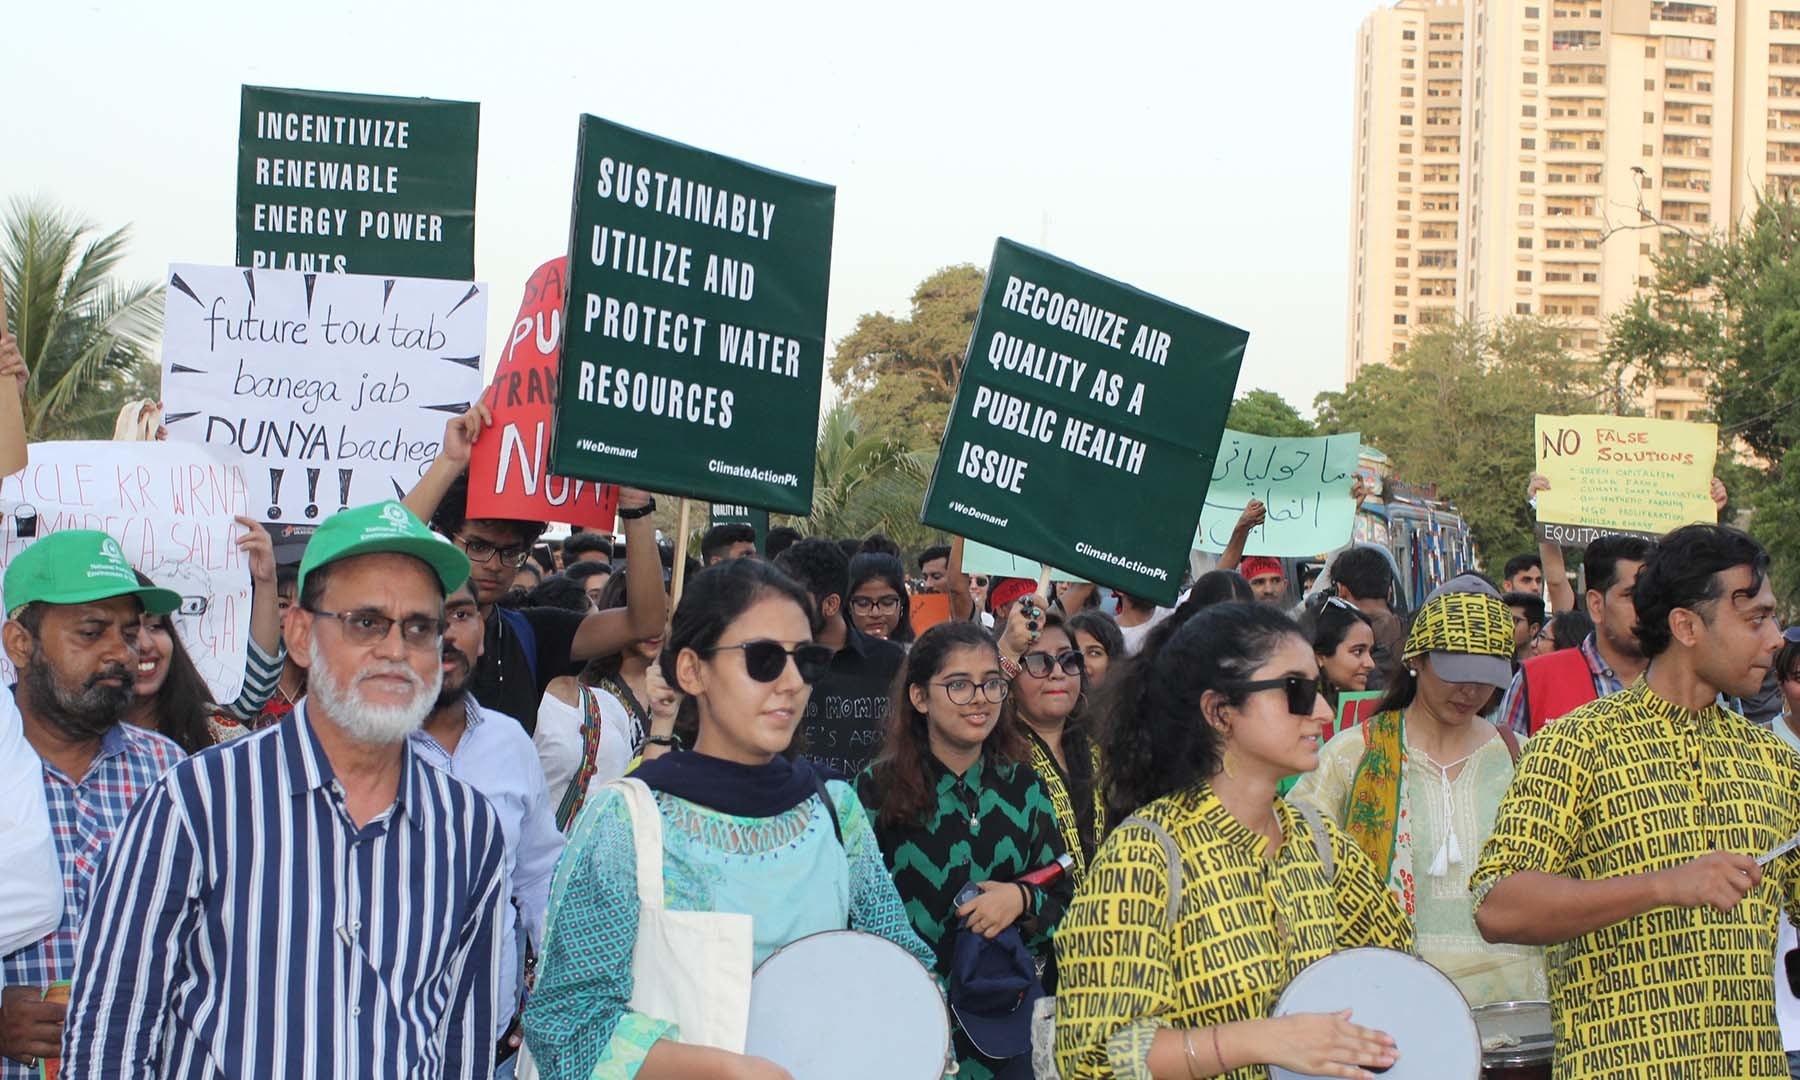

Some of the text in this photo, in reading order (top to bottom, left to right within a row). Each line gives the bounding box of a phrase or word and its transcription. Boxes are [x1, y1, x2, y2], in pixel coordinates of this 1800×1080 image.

[257, 111, 410, 149] INCENTIVIZE
[256, 157, 399, 194] RENEWABLE
[597, 157, 776, 241] SUSTAINABLY
[254, 203, 443, 242] ENERGY POWER
[591, 225, 755, 302] UTILIZE AND
[203, 296, 447, 352] future tou tab
[584, 293, 800, 378] PROTECT WATER
[1001, 275, 1172, 367] RECOGNIZE AIR
[233, 359, 410, 414] banega jab
[987, 331, 1145, 416] QUALITY AS A
[578, 361, 735, 430] RESOURCES
[205, 415, 441, 477] DUNYA bacheg
[576, 439, 638, 459] #WeDemand
[971, 385, 1147, 476] PUBLIC HEALTH
[1542, 428, 1649, 459] NO FALSE
[708, 459, 798, 487] ClimateActionPk
[957, 441, 1028, 494] ISSUE
[1597, 447, 1694, 465] SOLUTIONS
[17, 464, 248, 517] YCLE KR WRNA
[948, 501, 1008, 528] #WeDemand
[1544, 524, 1620, 544] EQUITAB
[172, 521, 240, 570] SALA
[1075, 542, 1169, 582] ClimateActionPk
[826, 695, 897, 719] MOMM
[1525, 755, 1573, 787] GLOBAL
[1608, 787, 1660, 818] ACTION
[1585, 816, 1641, 855] CLIMATE
[1642, 807, 1690, 834] STRIKE
[1647, 907, 1695, 935] STRIKE
[1069, 930, 1142, 959] PAKISTAN
[1201, 932, 1261, 973] ACTION
[1650, 930, 1706, 960] CLIMATE
[1709, 927, 1754, 950] ACTION
[1110, 961, 1169, 996] CLIMATE
[1641, 955, 1701, 985] CLIMATE
[1704, 954, 1745, 977] STRIKE
[1618, 987, 1670, 1016] ACTION
[1673, 981, 1709, 1005] NOW!
[1712, 979, 1771, 1002] PAKISTAN
[1589, 1016, 1647, 1046] CLIMATE
[1650, 1008, 1701, 1036] STRIKE
[1703, 1005, 1748, 1028] GLOBAL
[1582, 1041, 1651, 1074] PAKISTAN
[1654, 1032, 1708, 1060] CLIMATE
[1709, 1030, 1754, 1053] ACTION
[1641, 1058, 1702, 1080] CLIMATE
[1704, 1055, 1743, 1080] STRIKE
[1749, 1055, 1789, 1078] GLOBAL
